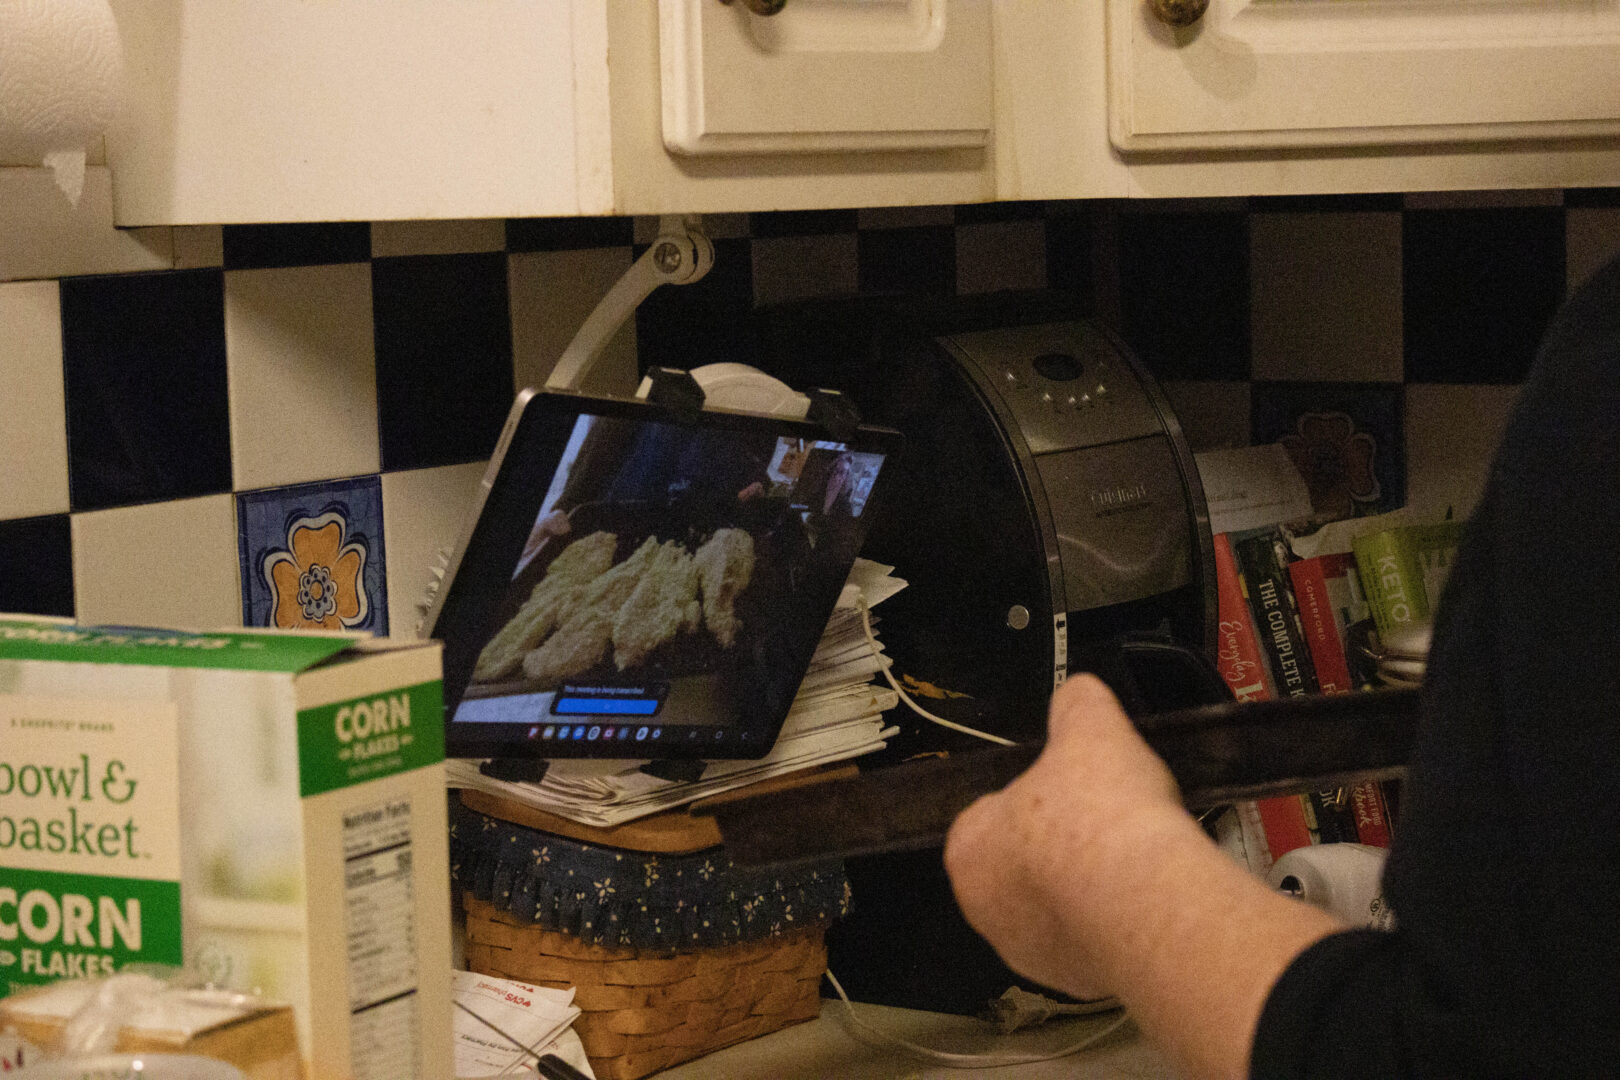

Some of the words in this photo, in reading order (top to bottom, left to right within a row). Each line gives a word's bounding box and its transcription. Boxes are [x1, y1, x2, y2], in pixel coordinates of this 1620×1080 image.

[1259, 579, 1279, 609] THE
[1304, 578, 1326, 641] COMERFORD
[1377, 555, 1411, 622] KETO
[1219, 620, 1256, 682] Everyday
[1267, 611, 1302, 687] COMPLETE
[334, 693, 411, 743] CORN
[102, 760, 138, 804] &
[0, 886, 142, 951] CORN
[21, 948, 115, 979] FLAKES
[504, 993, 525, 1006] CVS
